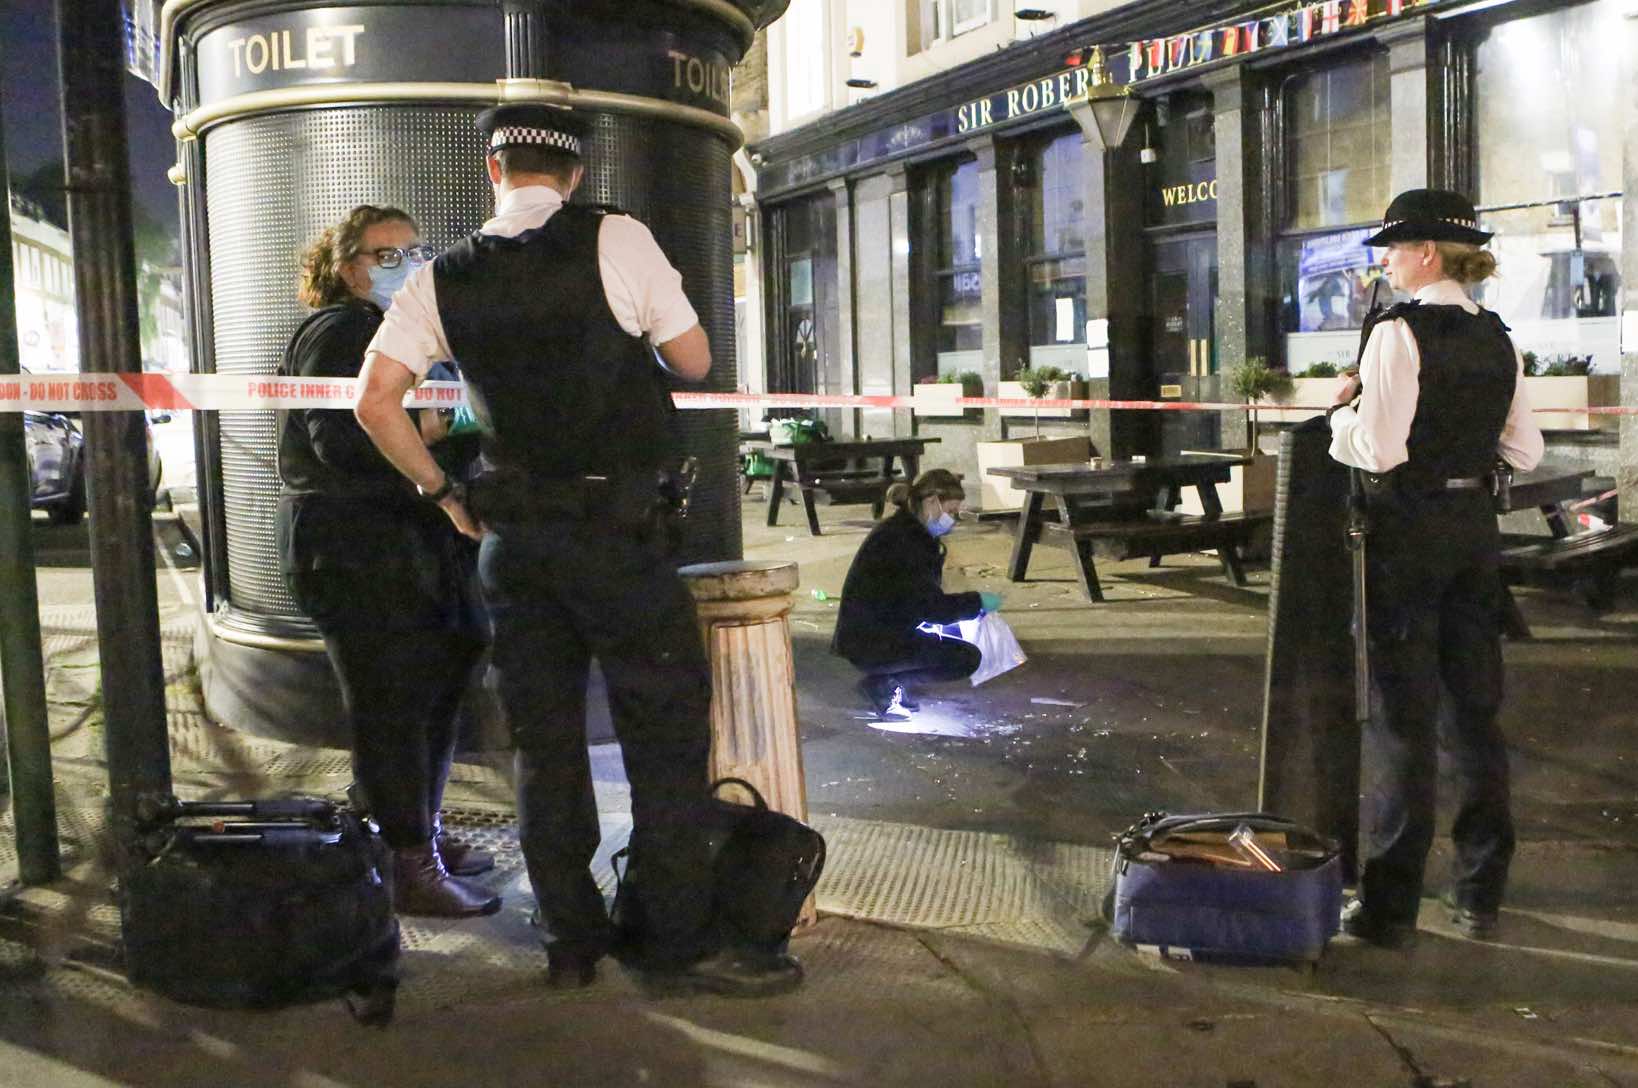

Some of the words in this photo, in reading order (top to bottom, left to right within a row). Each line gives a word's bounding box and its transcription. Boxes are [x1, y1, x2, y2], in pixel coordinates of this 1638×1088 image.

[228, 25, 365, 78] TOILET
[958, 99, 993, 133] SIR
[1007, 66, 1095, 119] ROBER
[30, 383, 45, 400] DO
[48, 383, 69, 400] NOT
[73, 382, 117, 401] CROSS
[248, 382, 297, 398] POLICE
[300, 383, 342, 399] INNER
